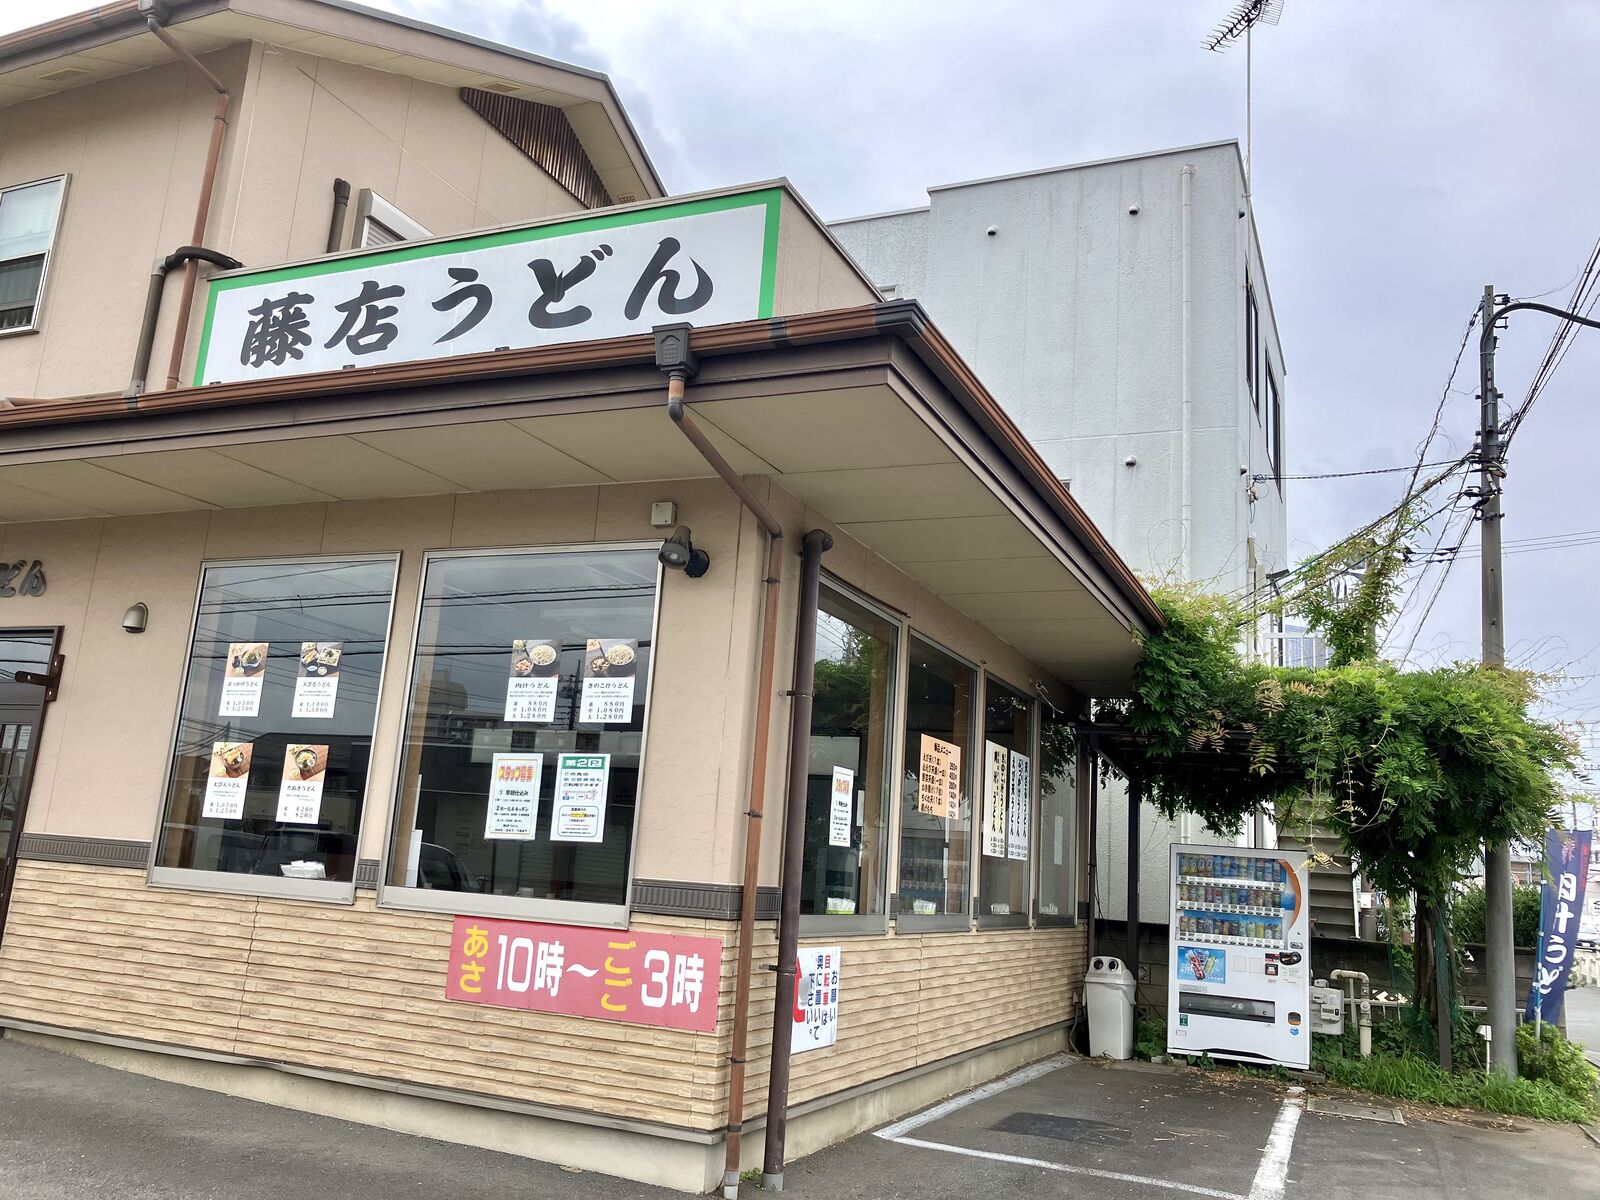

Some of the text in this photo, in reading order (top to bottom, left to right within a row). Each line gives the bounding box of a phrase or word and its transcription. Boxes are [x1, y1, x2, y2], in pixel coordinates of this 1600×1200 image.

[240, 237, 714, 367] 藤店うどん
[459, 925, 489, 993] あさ
[601, 941, 636, 1011] ごご
[641, 949, 704, 1013] 3時
[1533, 870, 1577, 1003] 肉汁うど
